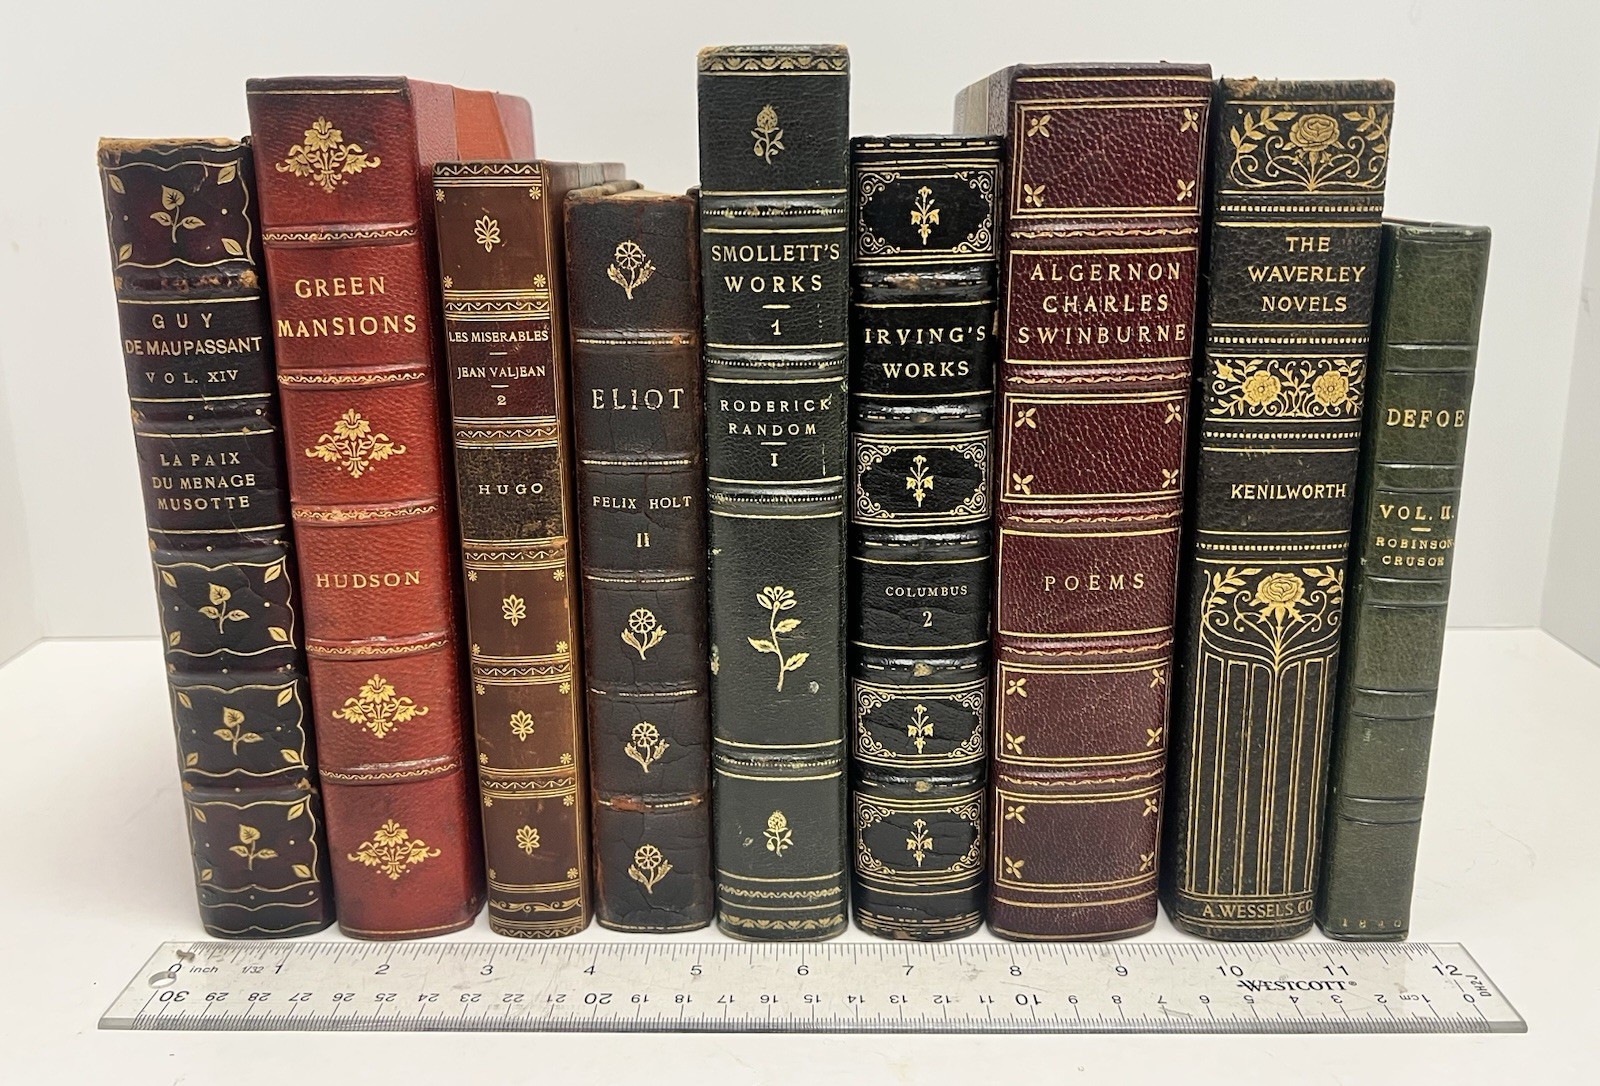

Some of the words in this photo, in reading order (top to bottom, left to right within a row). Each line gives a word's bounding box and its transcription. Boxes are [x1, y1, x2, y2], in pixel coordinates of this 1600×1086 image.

[1285, 237, 1331, 252] THE
[711, 243, 840, 262] SMOLLETT'S
[1030, 263, 1181, 282] ALGERNON
[1248, 265, 1366, 283] WAVERLEY
[295, 276, 385, 298] GREEN
[724, 274, 822, 294] WORKS
[1042, 295, 1169, 314] CHARLES
[1261, 296, 1347, 312] NOVELS
[152, 313, 213, 330] GUY
[278, 314, 417, 338] MANSIONS
[771, 319, 782, 336] 1
[449, 332, 468, 343] LES
[471, 330, 549, 342] MISERABLES
[864, 326, 986, 346] IRVING'S
[1018, 324, 1186, 344] SWINBURNE
[125, 339, 143, 355] DE
[146, 337, 262, 356] MAUPASSANT
[457, 366, 486, 379] JEAN
[490, 366, 546, 379] VALJEAN
[883, 361, 969, 379] WORKS
[146, 372, 198, 384] VOL.
[207, 370, 239, 383] XIV
[496, 396, 507, 406] 2
[592, 388, 684, 411] ELIOT
[720, 399, 830, 412] RODERICK
[1387, 408, 1465, 428] DEFOE
[728, 422, 816, 436] RANDOM
[161, 454, 182, 466] LA
[191, 452, 241, 466] PAIX
[152, 476, 173, 489] DU
[180, 474, 256, 488] MENAGE
[478, 482, 543, 495] HUGO
[1231, 483, 1347, 500] KENILWORTH
[157, 495, 250, 511] MUSOTTE
[593, 496, 637, 509] FELIX
[649, 496, 692, 510] HOLT
[1380, 505, 1433, 521] VOL.
[1375, 537, 1454, 549] ROBINSON
[1382, 555, 1444, 566] CRUSOE
[316, 571, 421, 589] HUDSON
[1044, 573, 1145, 592] POEMS
[885, 586, 968, 597] COLUMBUS
[922, 611, 933, 628] 2
[168, 964, 182, 973] 0
[189, 964, 219, 973] inch
[241, 965, 265, 974] 1/32
[274, 964, 284, 974] 1
[375, 965, 390, 975] 2
[480, 965, 494, 975] 3
[583, 965, 596, 975] 4
[691, 965, 702, 975] 5
[797, 965, 809, 976] 6
[902, 965, 914, 975] 7
[1010, 966, 1022, 976] 8
[1115, 966, 1128, 976] 9
[1216, 966, 1243, 977] 10
[1323, 966, 1349, 976] 11
[1432, 965, 1462, 976] 12
[159, 991, 189, 1002] 30
[205, 992, 229, 1001] 29
[247, 992, 272, 1001] 28
[288, 992, 313, 1001] 27
[332, 993, 355, 1001] 26
[375, 993, 398, 1002] 25
[418, 993, 440, 1002] 24
[460, 993, 482, 1002] 23
[503, 994, 524, 1002] 22
[547, 994, 566, 1002] 21
[584, 993, 613, 1005] 20
[631, 994, 649, 1002] 19
[675, 994, 692, 1003] 18
[717, 994, 735, 1003] 17
[760, 994, 778, 1003] 16
[804, 994, 821, 1003] 15
[847, 995, 865, 1003] 14
[890, 995, 908, 1003] 13
[932, 995, 952, 1003] 12
[979, 995, 995, 1003] 11
[1015, 994, 1042, 1005] 10
[1068, 995, 1078, 1004] 9
[1112, 995, 1122, 1004] 8
[1158, 995, 1167, 1004] 7
[1199, 995, 1210, 1004] 6
[1243, 995, 1254, 1004] 5
[1289, 995, 1300, 1004] 4
[1331, 995, 1343, 1004] 3
[1374, 994, 1388, 1004] 2
[1463, 994, 1475, 1003] 0
